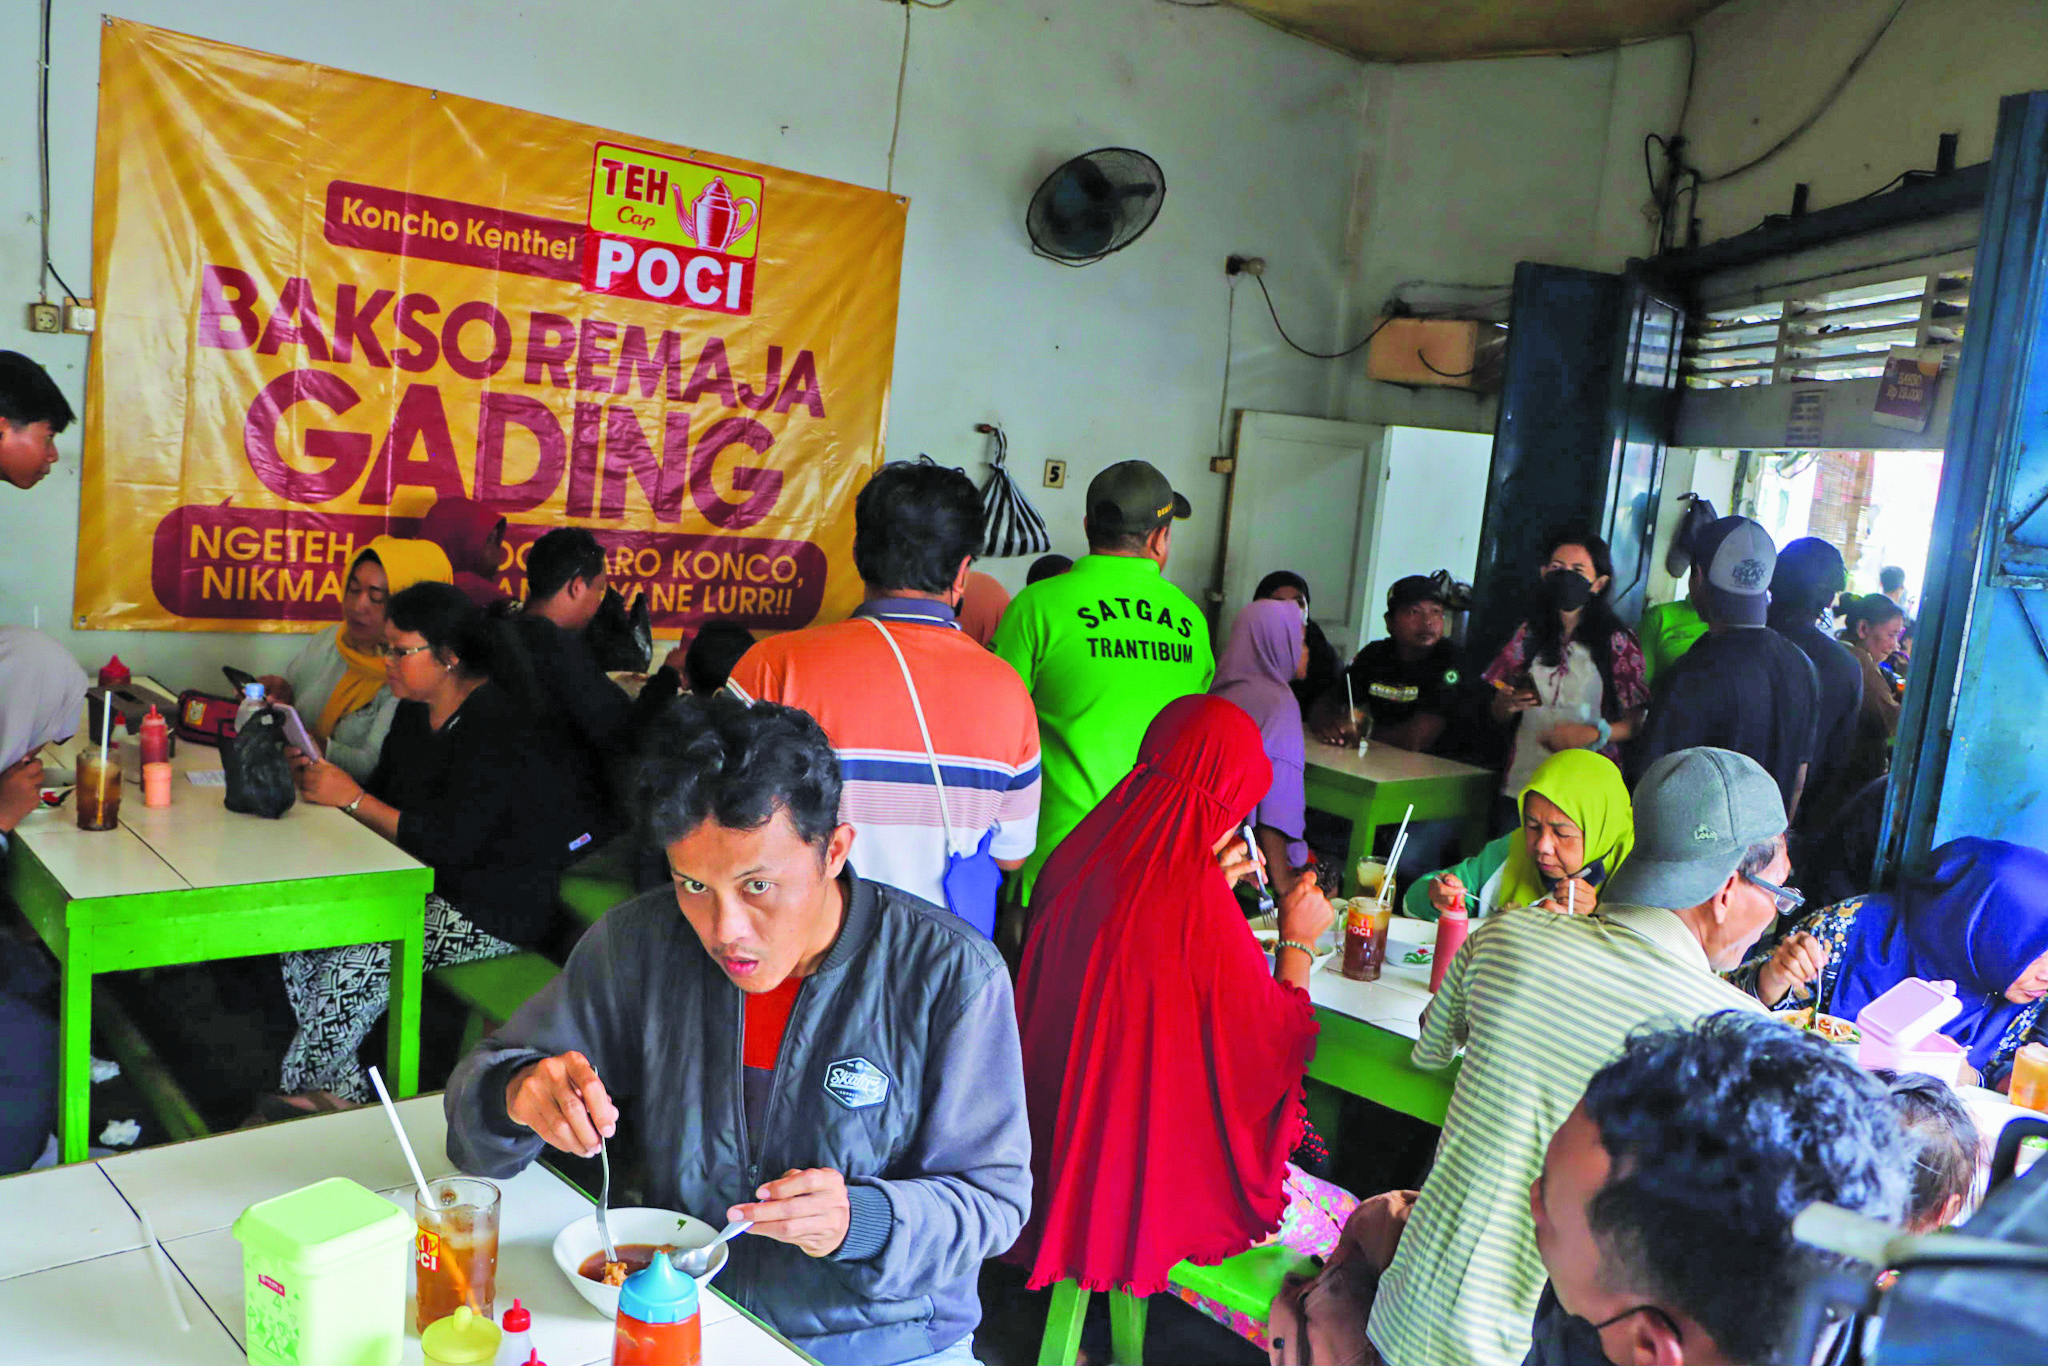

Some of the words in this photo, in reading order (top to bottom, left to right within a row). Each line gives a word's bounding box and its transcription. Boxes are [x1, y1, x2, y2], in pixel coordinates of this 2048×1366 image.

[601, 157, 669, 207] TEH
[342, 196, 459, 242] Koncho
[466, 219, 576, 261] Kenthel
[617, 205, 656, 231] Cap
[595, 238, 743, 310] POCI
[199, 263, 513, 381] BAKSO
[524, 311, 826, 418] REMAJA
[244, 368, 784, 531] GADING
[1049, 466, 1061, 483] 5
[190, 524, 354, 565] NGETEH
[673, 550, 804, 588] KONCO,
[202, 565, 344, 603] NIKMA
[703, 585, 793, 615] LURR!!
[1077, 597, 1193, 638] SATGAS
[1087, 637, 1193, 663] TRANTIBUM
